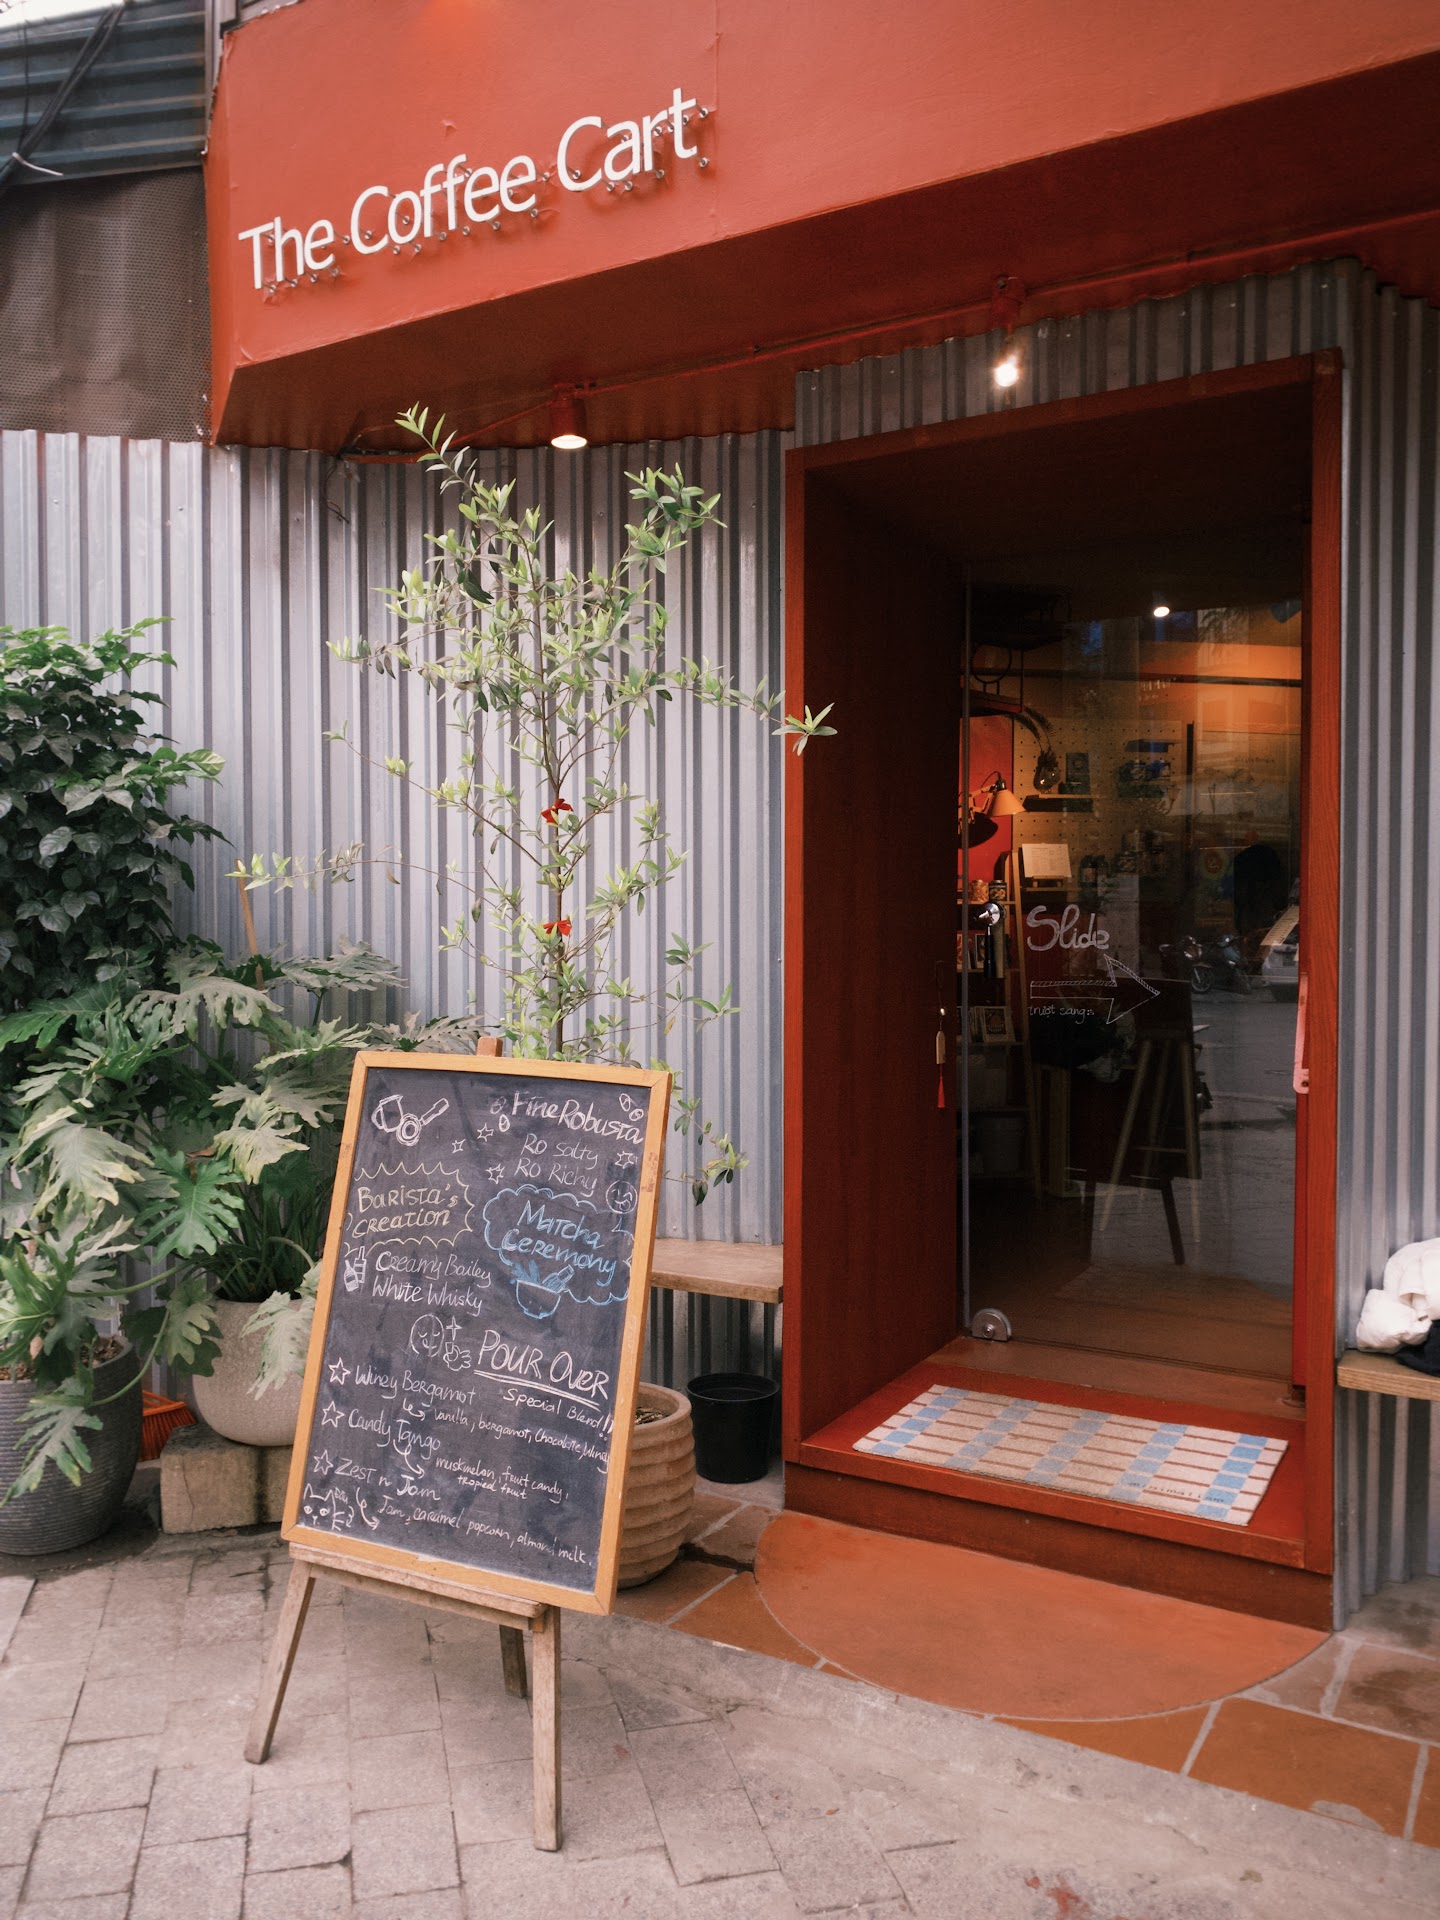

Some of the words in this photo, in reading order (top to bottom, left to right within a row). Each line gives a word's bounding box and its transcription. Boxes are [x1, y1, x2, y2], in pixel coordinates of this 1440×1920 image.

[238, 216, 334, 290] The
[350, 153, 537, 255] Coffee
[556, 87, 698, 193] Cart
[1026, 904, 1110, 951] Slide
[443, 1253, 492, 1289] Bailey
[371, 1274, 424, 1303] White
[427, 1281, 483, 1317] Whisky
[477, 1329, 543, 1380] POUR
[402, 1369, 477, 1408] Bergamot
[502, 1388, 562, 1415] Special
[348, 1408, 391, 1447] Candy
[396, 1419, 442, 1460] Tango
[500, 1482, 528, 1500] fruit
[501, 1466, 530, 1487] fruit
